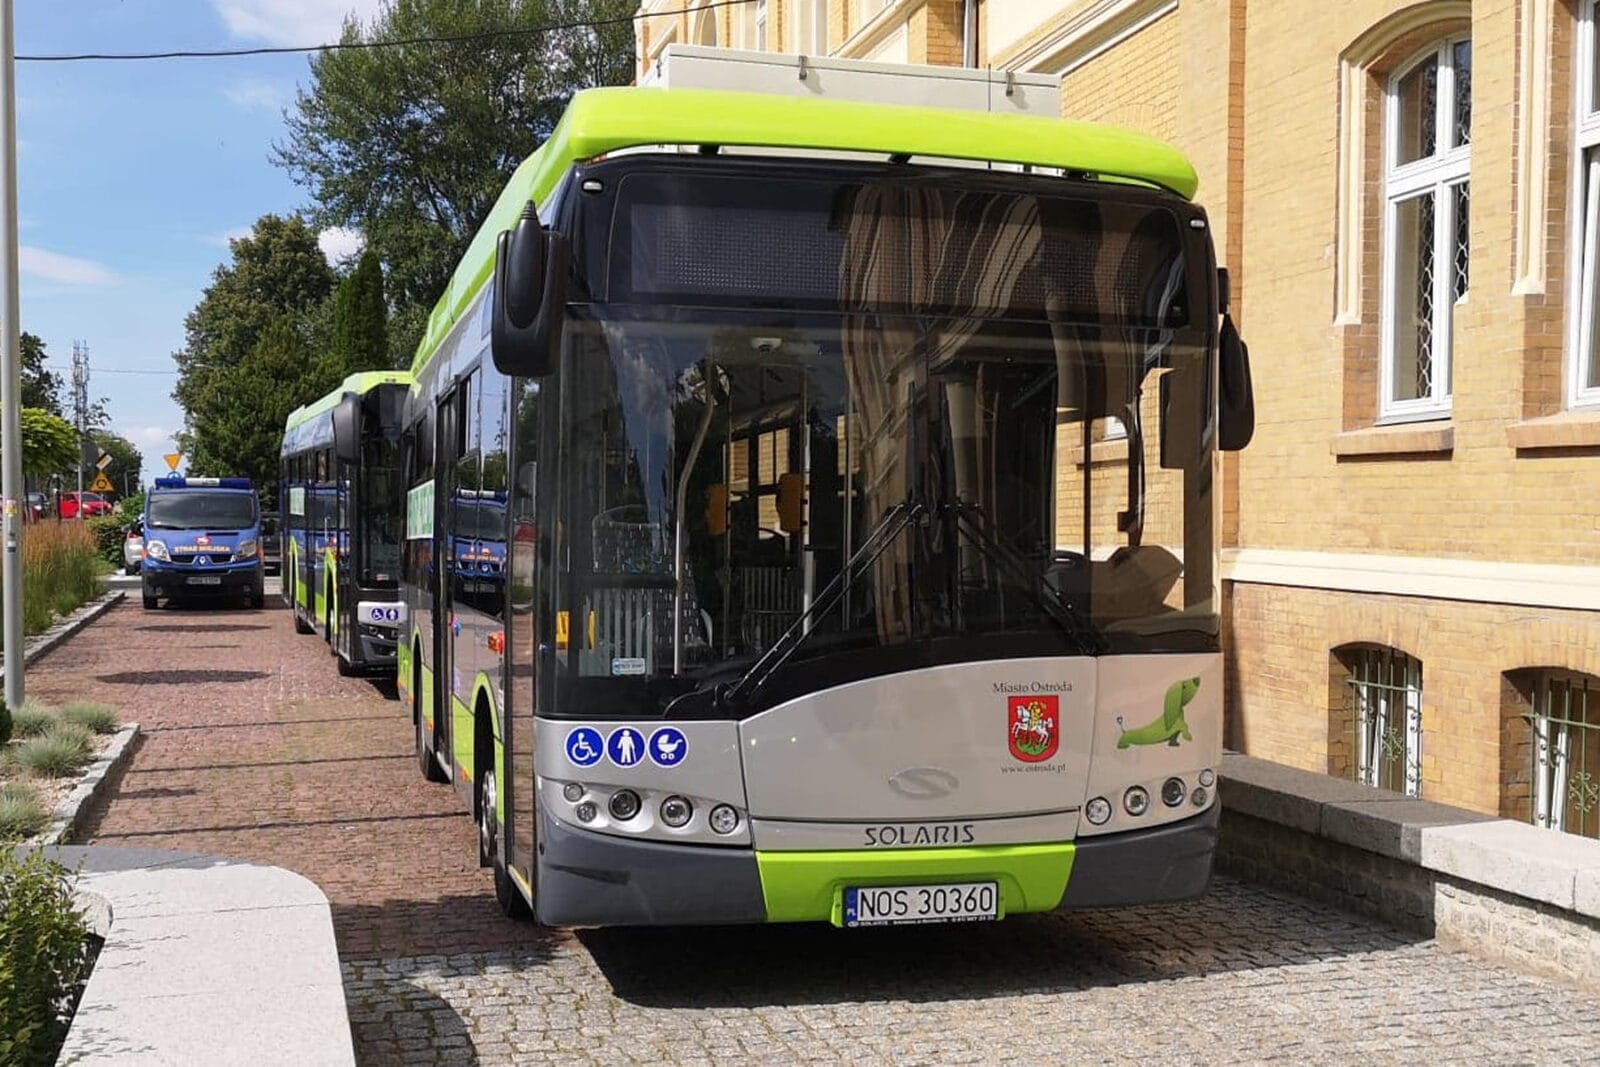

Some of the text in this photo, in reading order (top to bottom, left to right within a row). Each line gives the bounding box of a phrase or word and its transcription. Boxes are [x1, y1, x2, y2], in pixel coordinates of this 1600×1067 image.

[993, 681, 1072, 694] Miasto Ostróda
[865, 825, 975, 846] SOLARIS
[860, 886, 993, 918] NOS 30360
